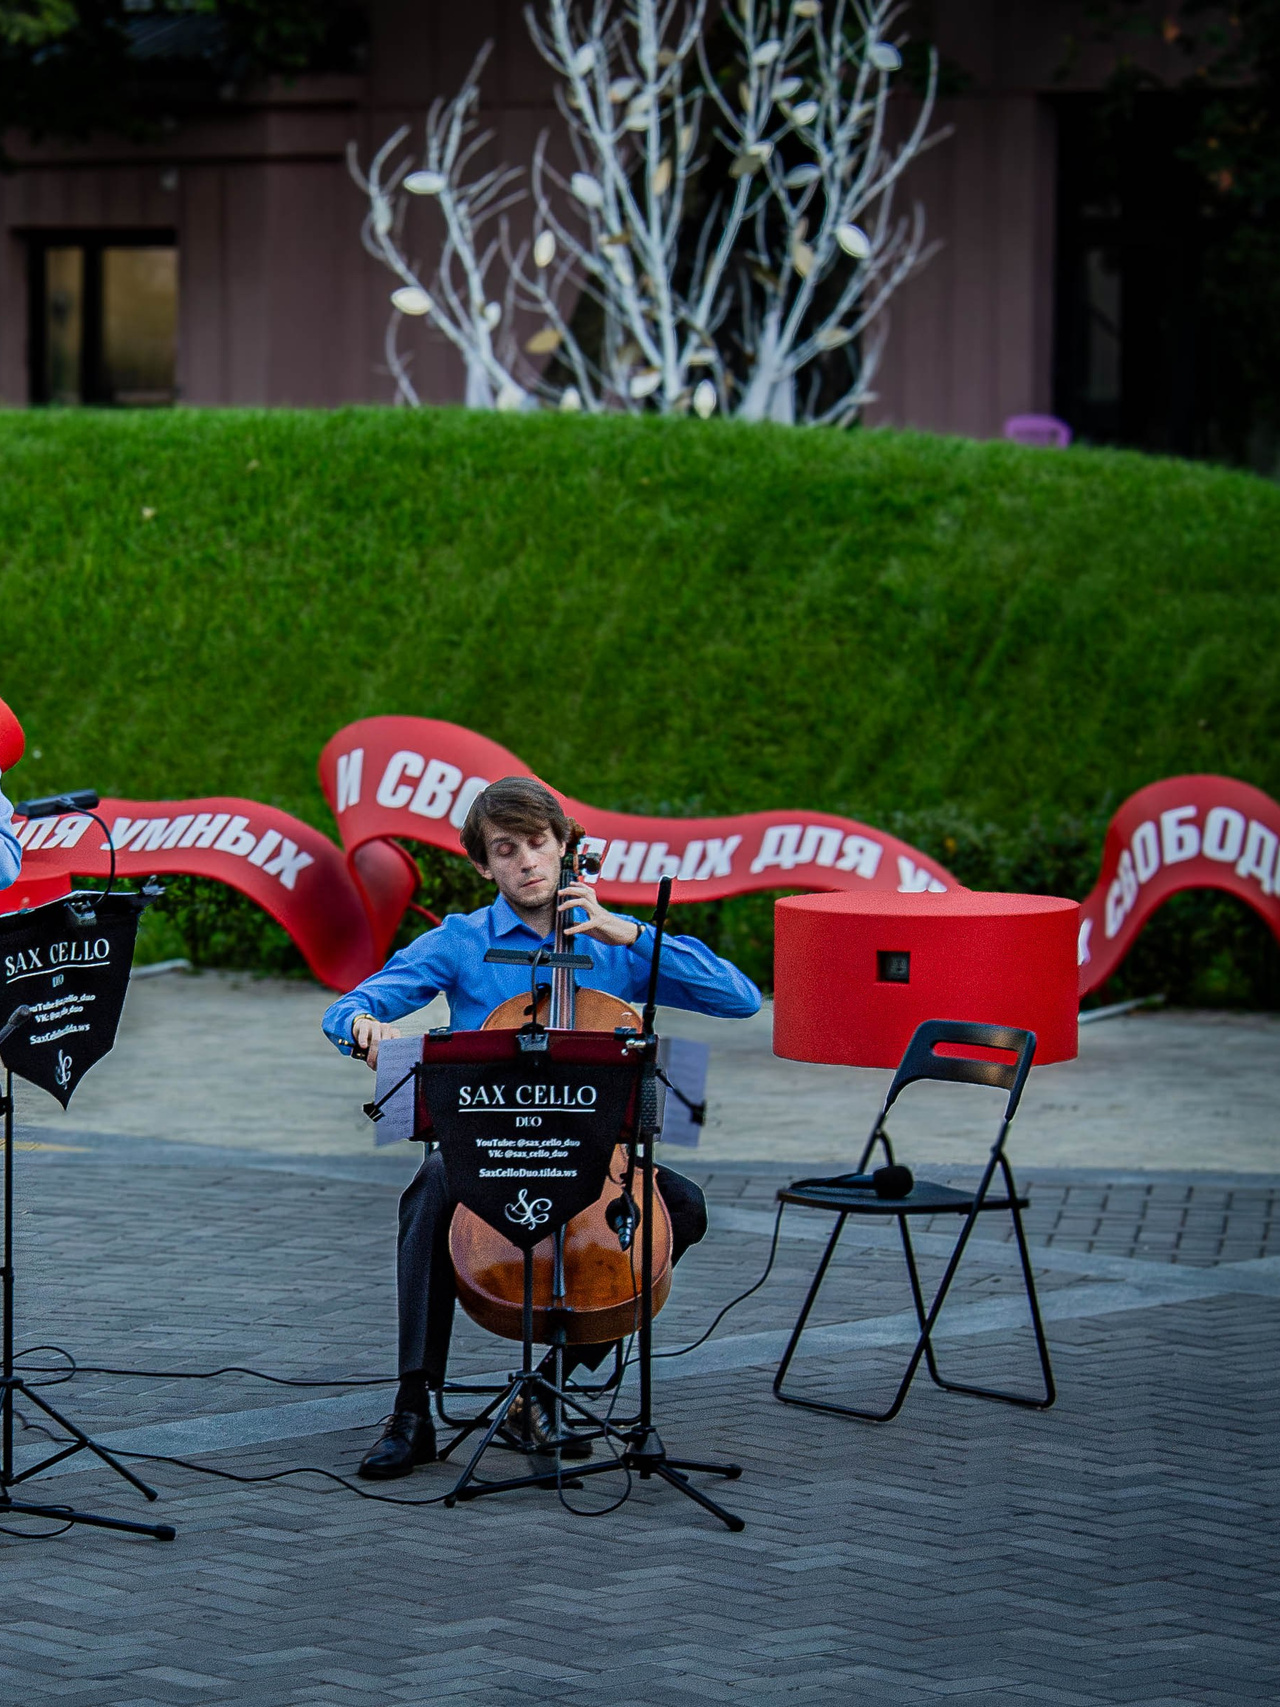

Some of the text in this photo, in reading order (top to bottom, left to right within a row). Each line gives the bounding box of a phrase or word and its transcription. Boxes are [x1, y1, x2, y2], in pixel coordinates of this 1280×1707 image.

[11, 812, 315, 891] ЛЯ УМНЫХ
[750, 823, 884, 880] ДЛЯ
[1104, 804, 1280, 940] СВОБОД
[5, 938, 110, 977] SAX CELLO
[458, 1084, 597, 1106] SAX CELLO
